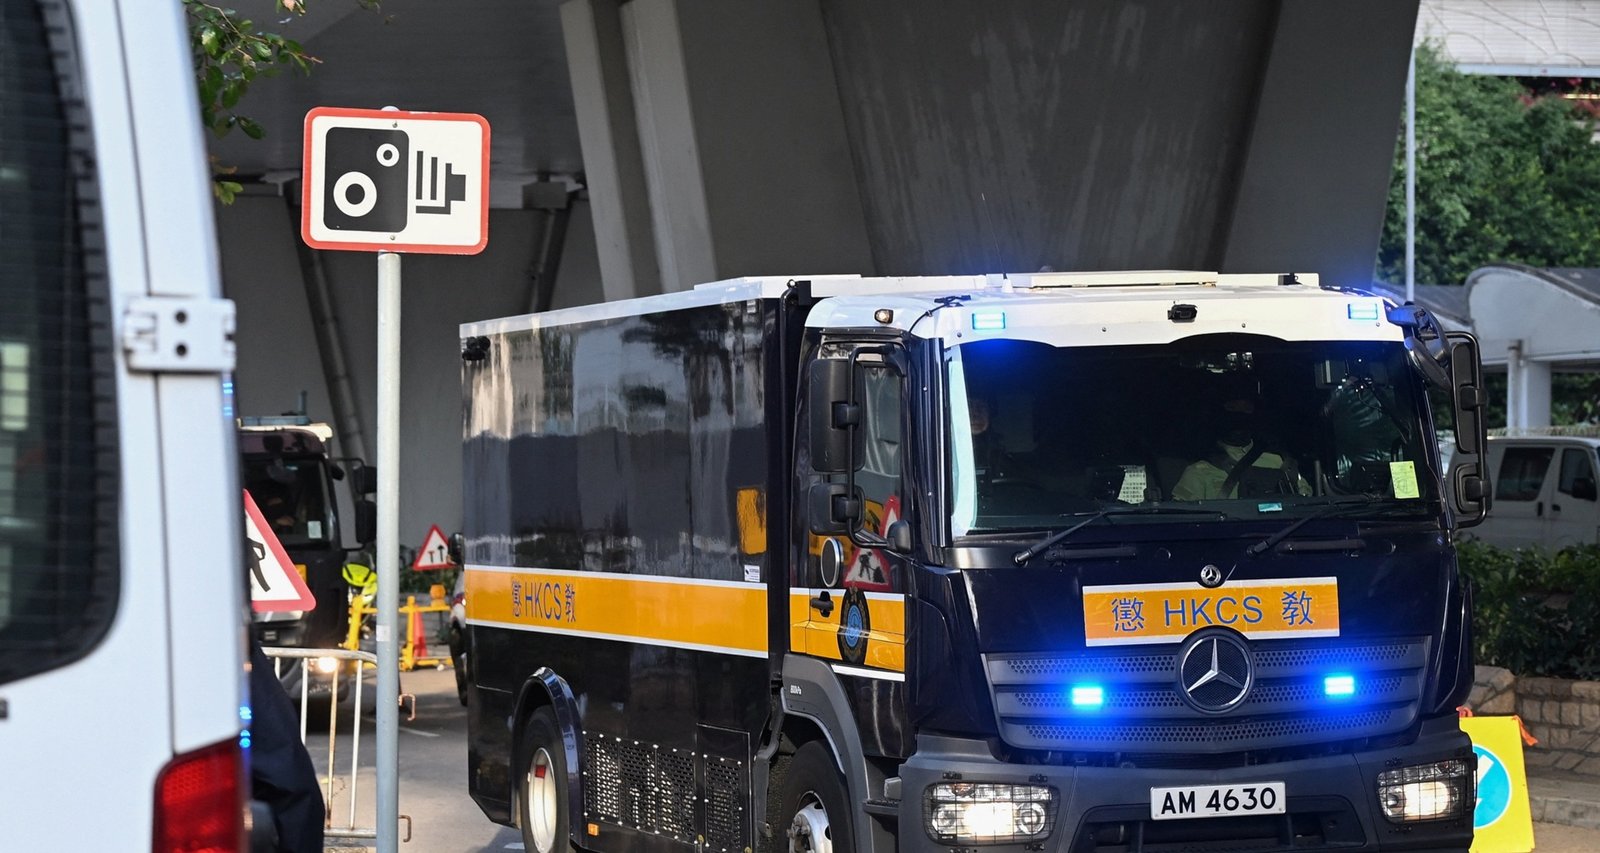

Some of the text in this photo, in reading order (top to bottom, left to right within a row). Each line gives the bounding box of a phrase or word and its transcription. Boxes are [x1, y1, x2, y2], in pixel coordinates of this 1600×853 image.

[524, 582, 562, 621] HKCS
[1111, 597, 1145, 632] 懲
[1164, 596, 1263, 626] HKCS
[1160, 787, 1277, 815] AM 4630
